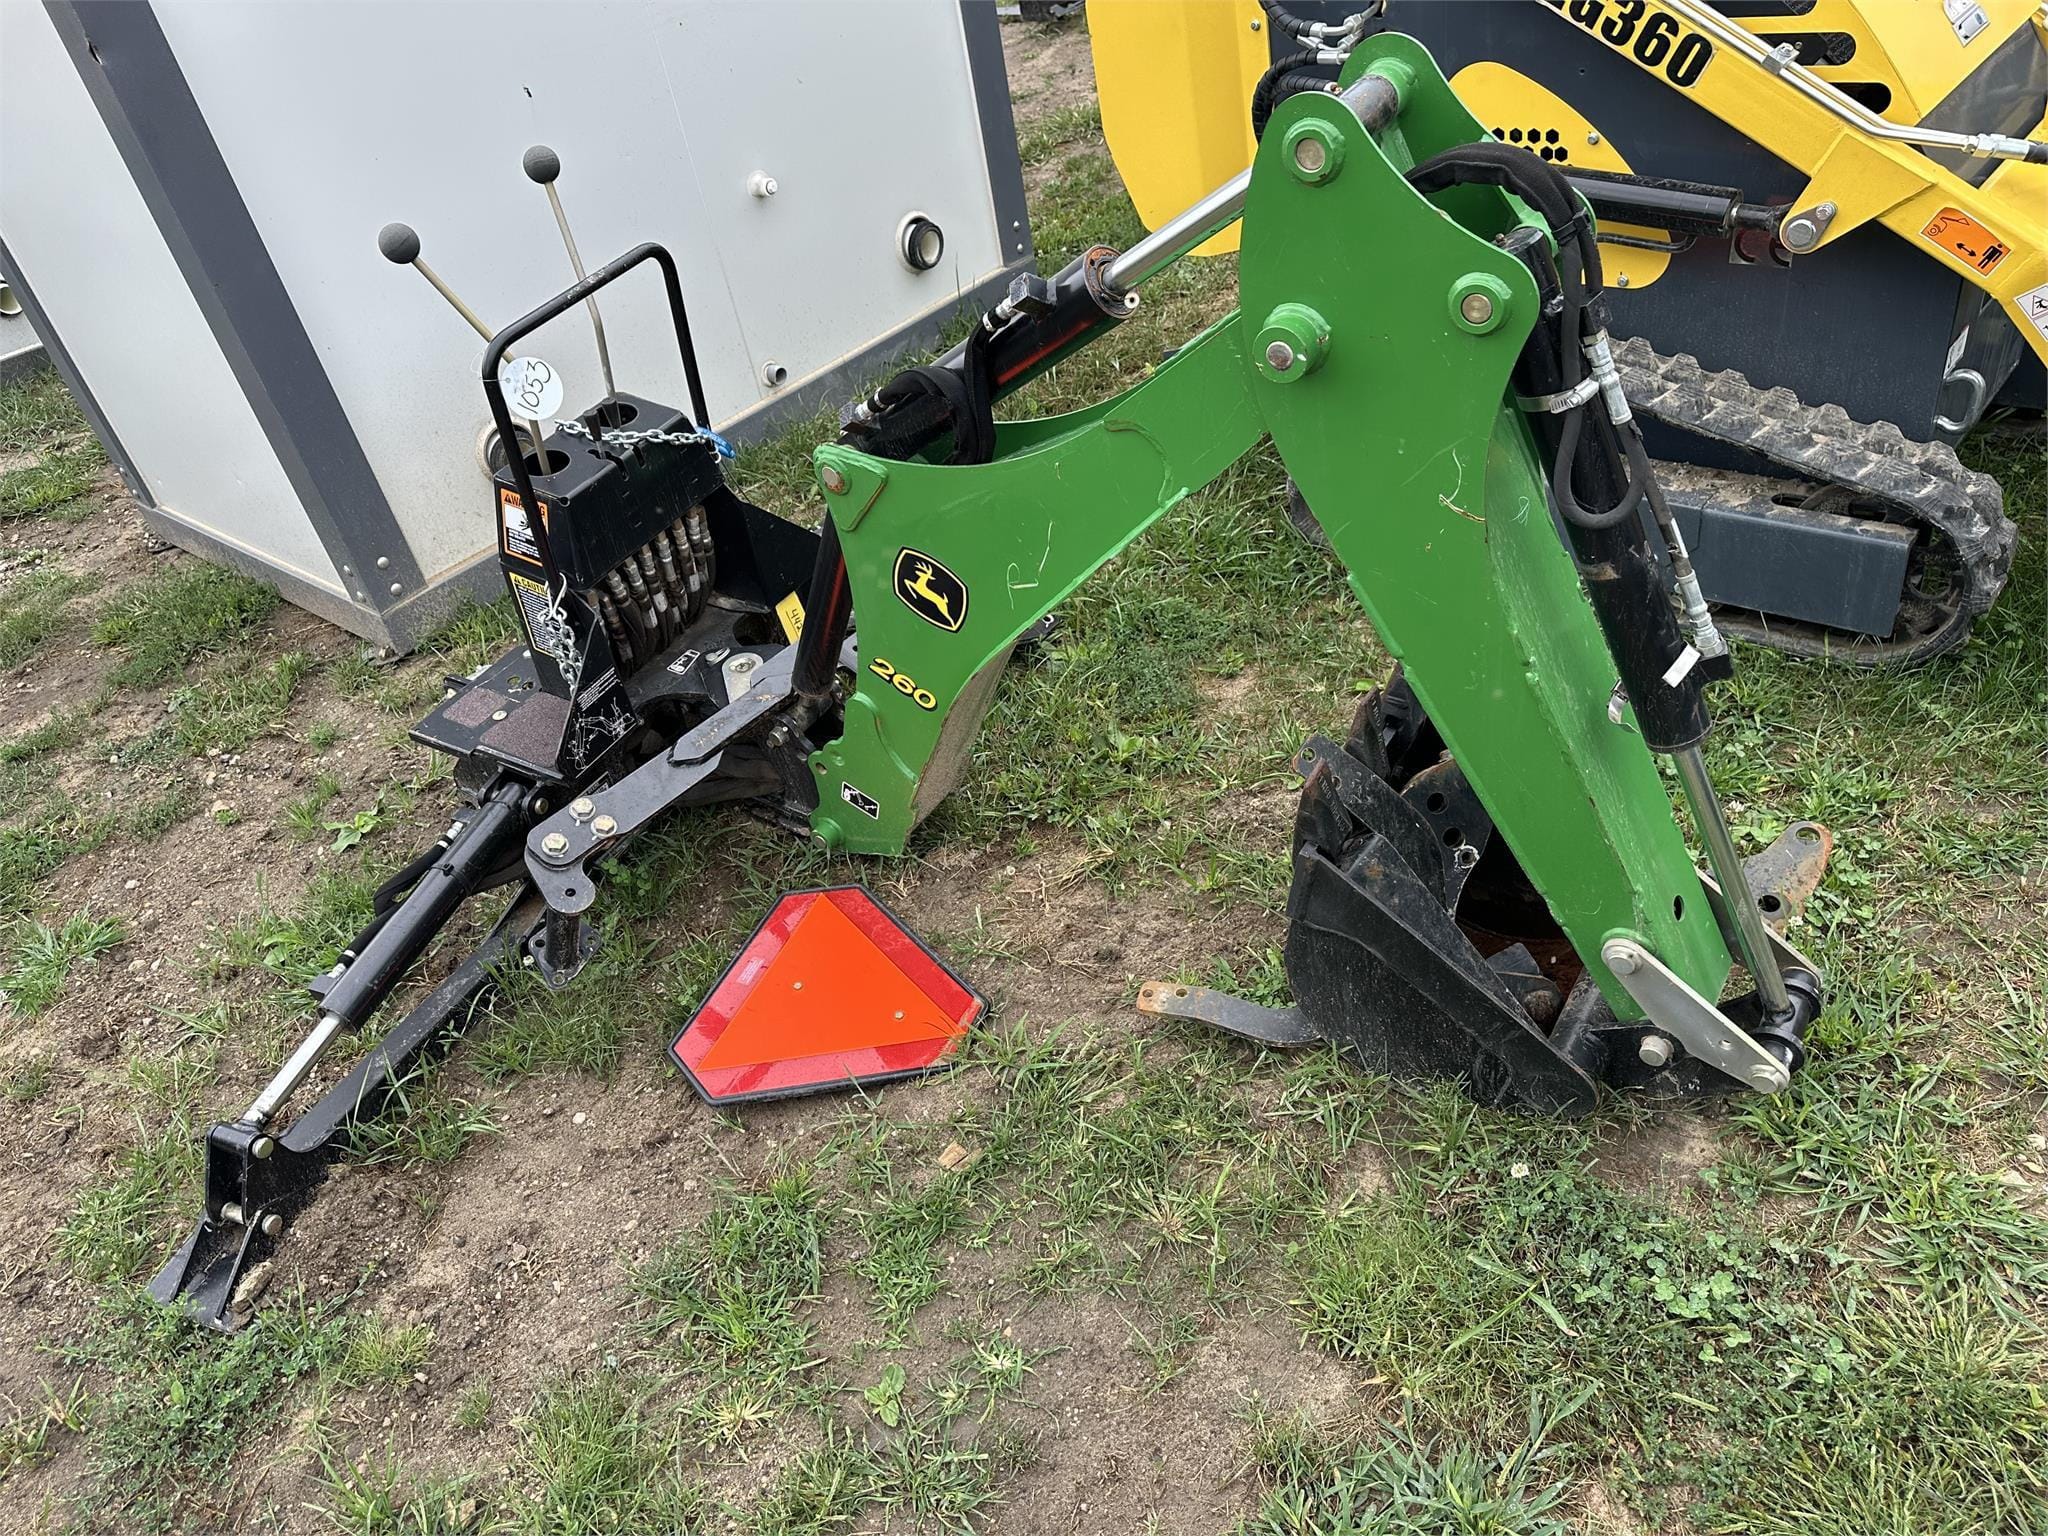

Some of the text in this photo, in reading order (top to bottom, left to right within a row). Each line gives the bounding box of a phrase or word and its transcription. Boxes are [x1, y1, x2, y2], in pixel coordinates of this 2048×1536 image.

[1547, 0, 1713, 87] G360
[517, 361, 551, 414] 1053
[868, 656, 938, 712] 260
